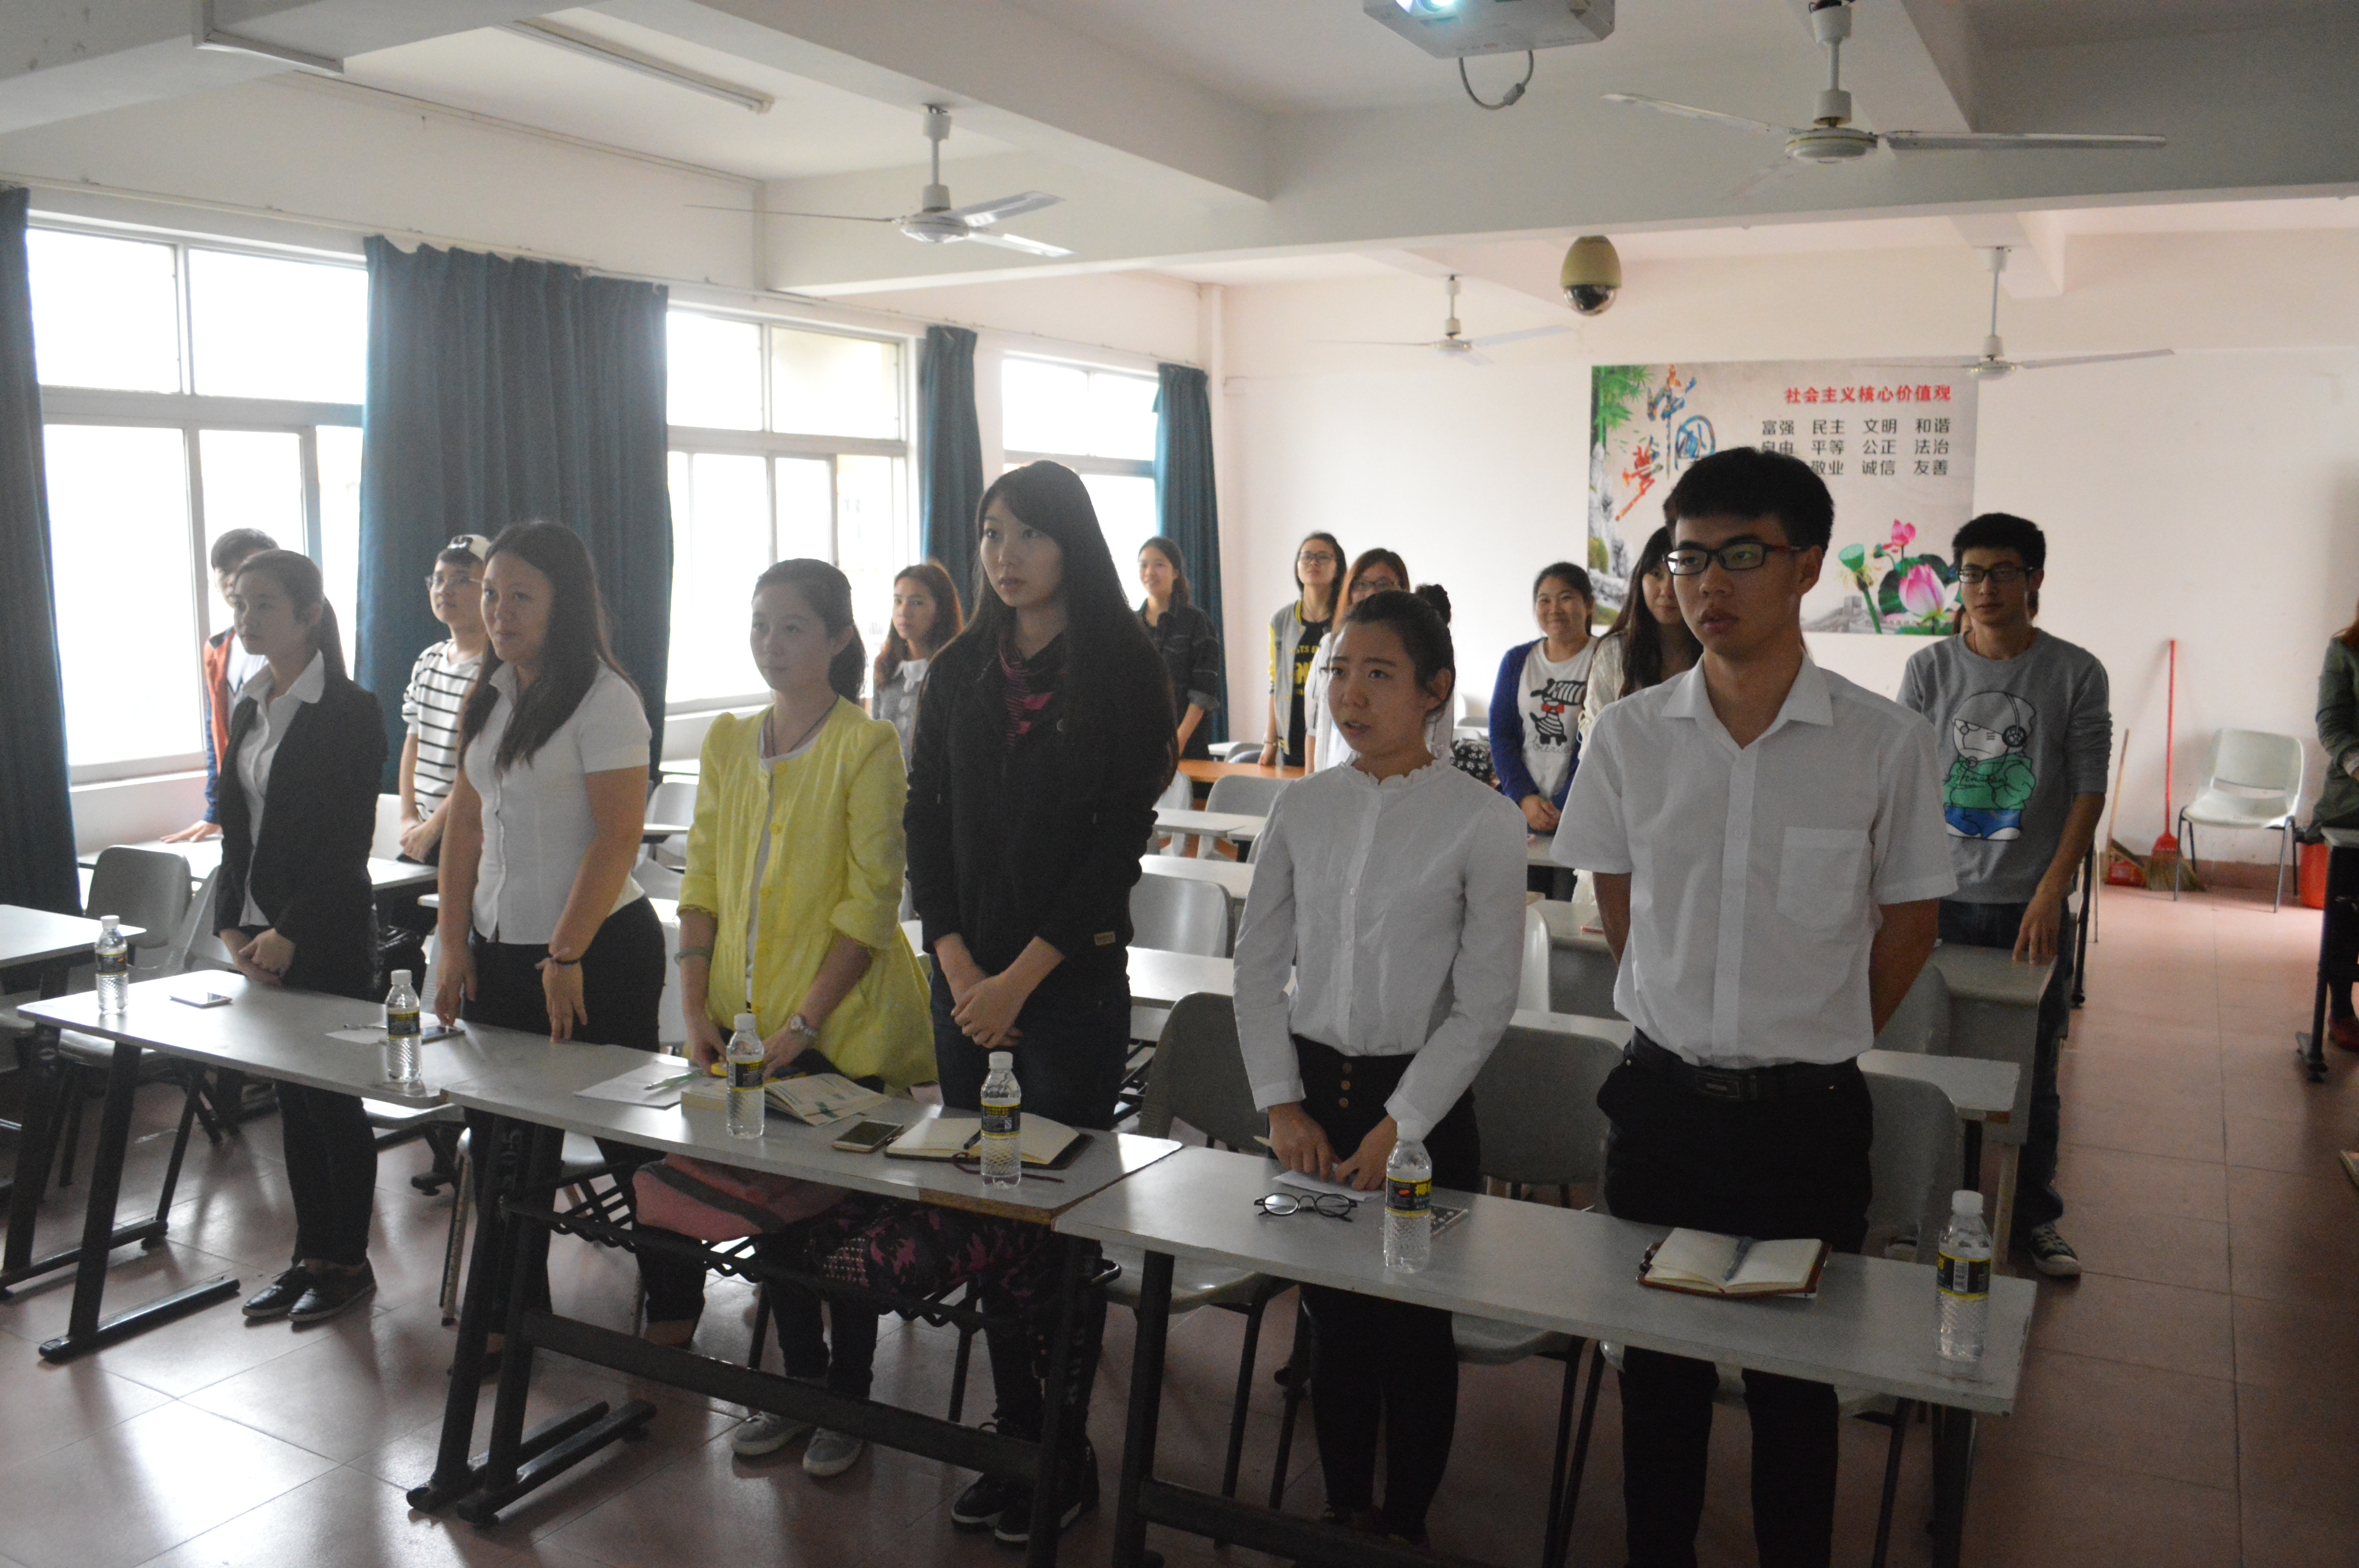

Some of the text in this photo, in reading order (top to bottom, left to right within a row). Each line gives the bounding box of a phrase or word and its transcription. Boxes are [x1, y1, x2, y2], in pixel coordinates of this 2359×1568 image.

[1786, 384, 1952, 404] 社会主义核心价值观
[1762, 417, 1950, 436] 富强 民主 文明 和谐
[1812, 439, 1844, 455] 平等
[1863, 439, 1896, 455] 公正
[1915, 438, 1949, 455] 法治
[1810, 459, 1948, 476] 敬业 诚信 友善
